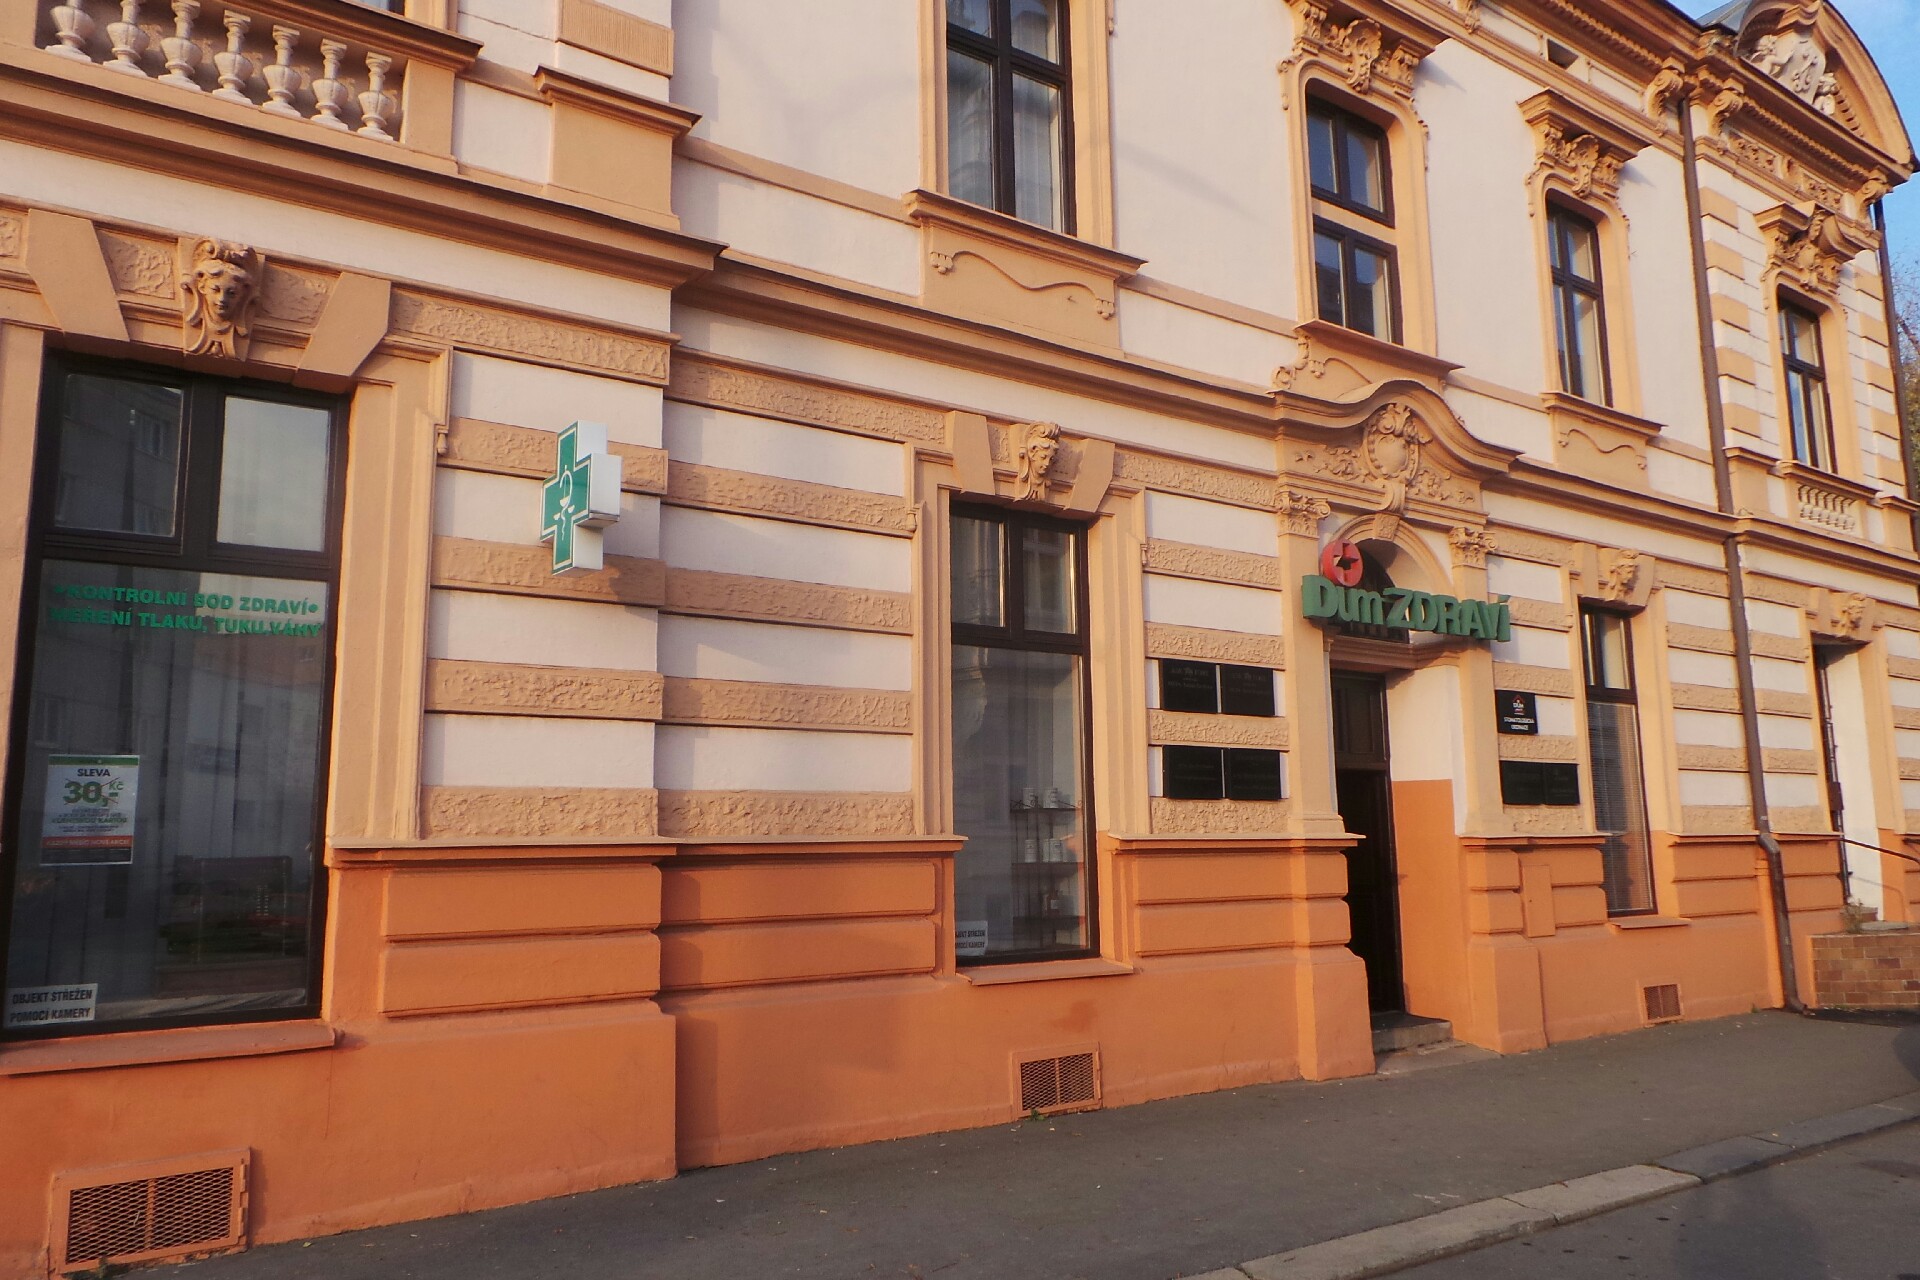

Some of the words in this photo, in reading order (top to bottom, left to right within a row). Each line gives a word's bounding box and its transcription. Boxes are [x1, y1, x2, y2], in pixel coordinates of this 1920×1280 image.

[193, 591, 233, 609] BOD
[239, 596, 309, 615] ZDRAVÍ
[1383, 587, 1511, 642] ZDRAVÍ
[77, 768, 111, 777] SLEVA
[12, 992, 49, 1004] OBJEKT
[51, 988, 93, 1002] STŘEŽEN
[51, 1007, 90, 1020] KAMERY
